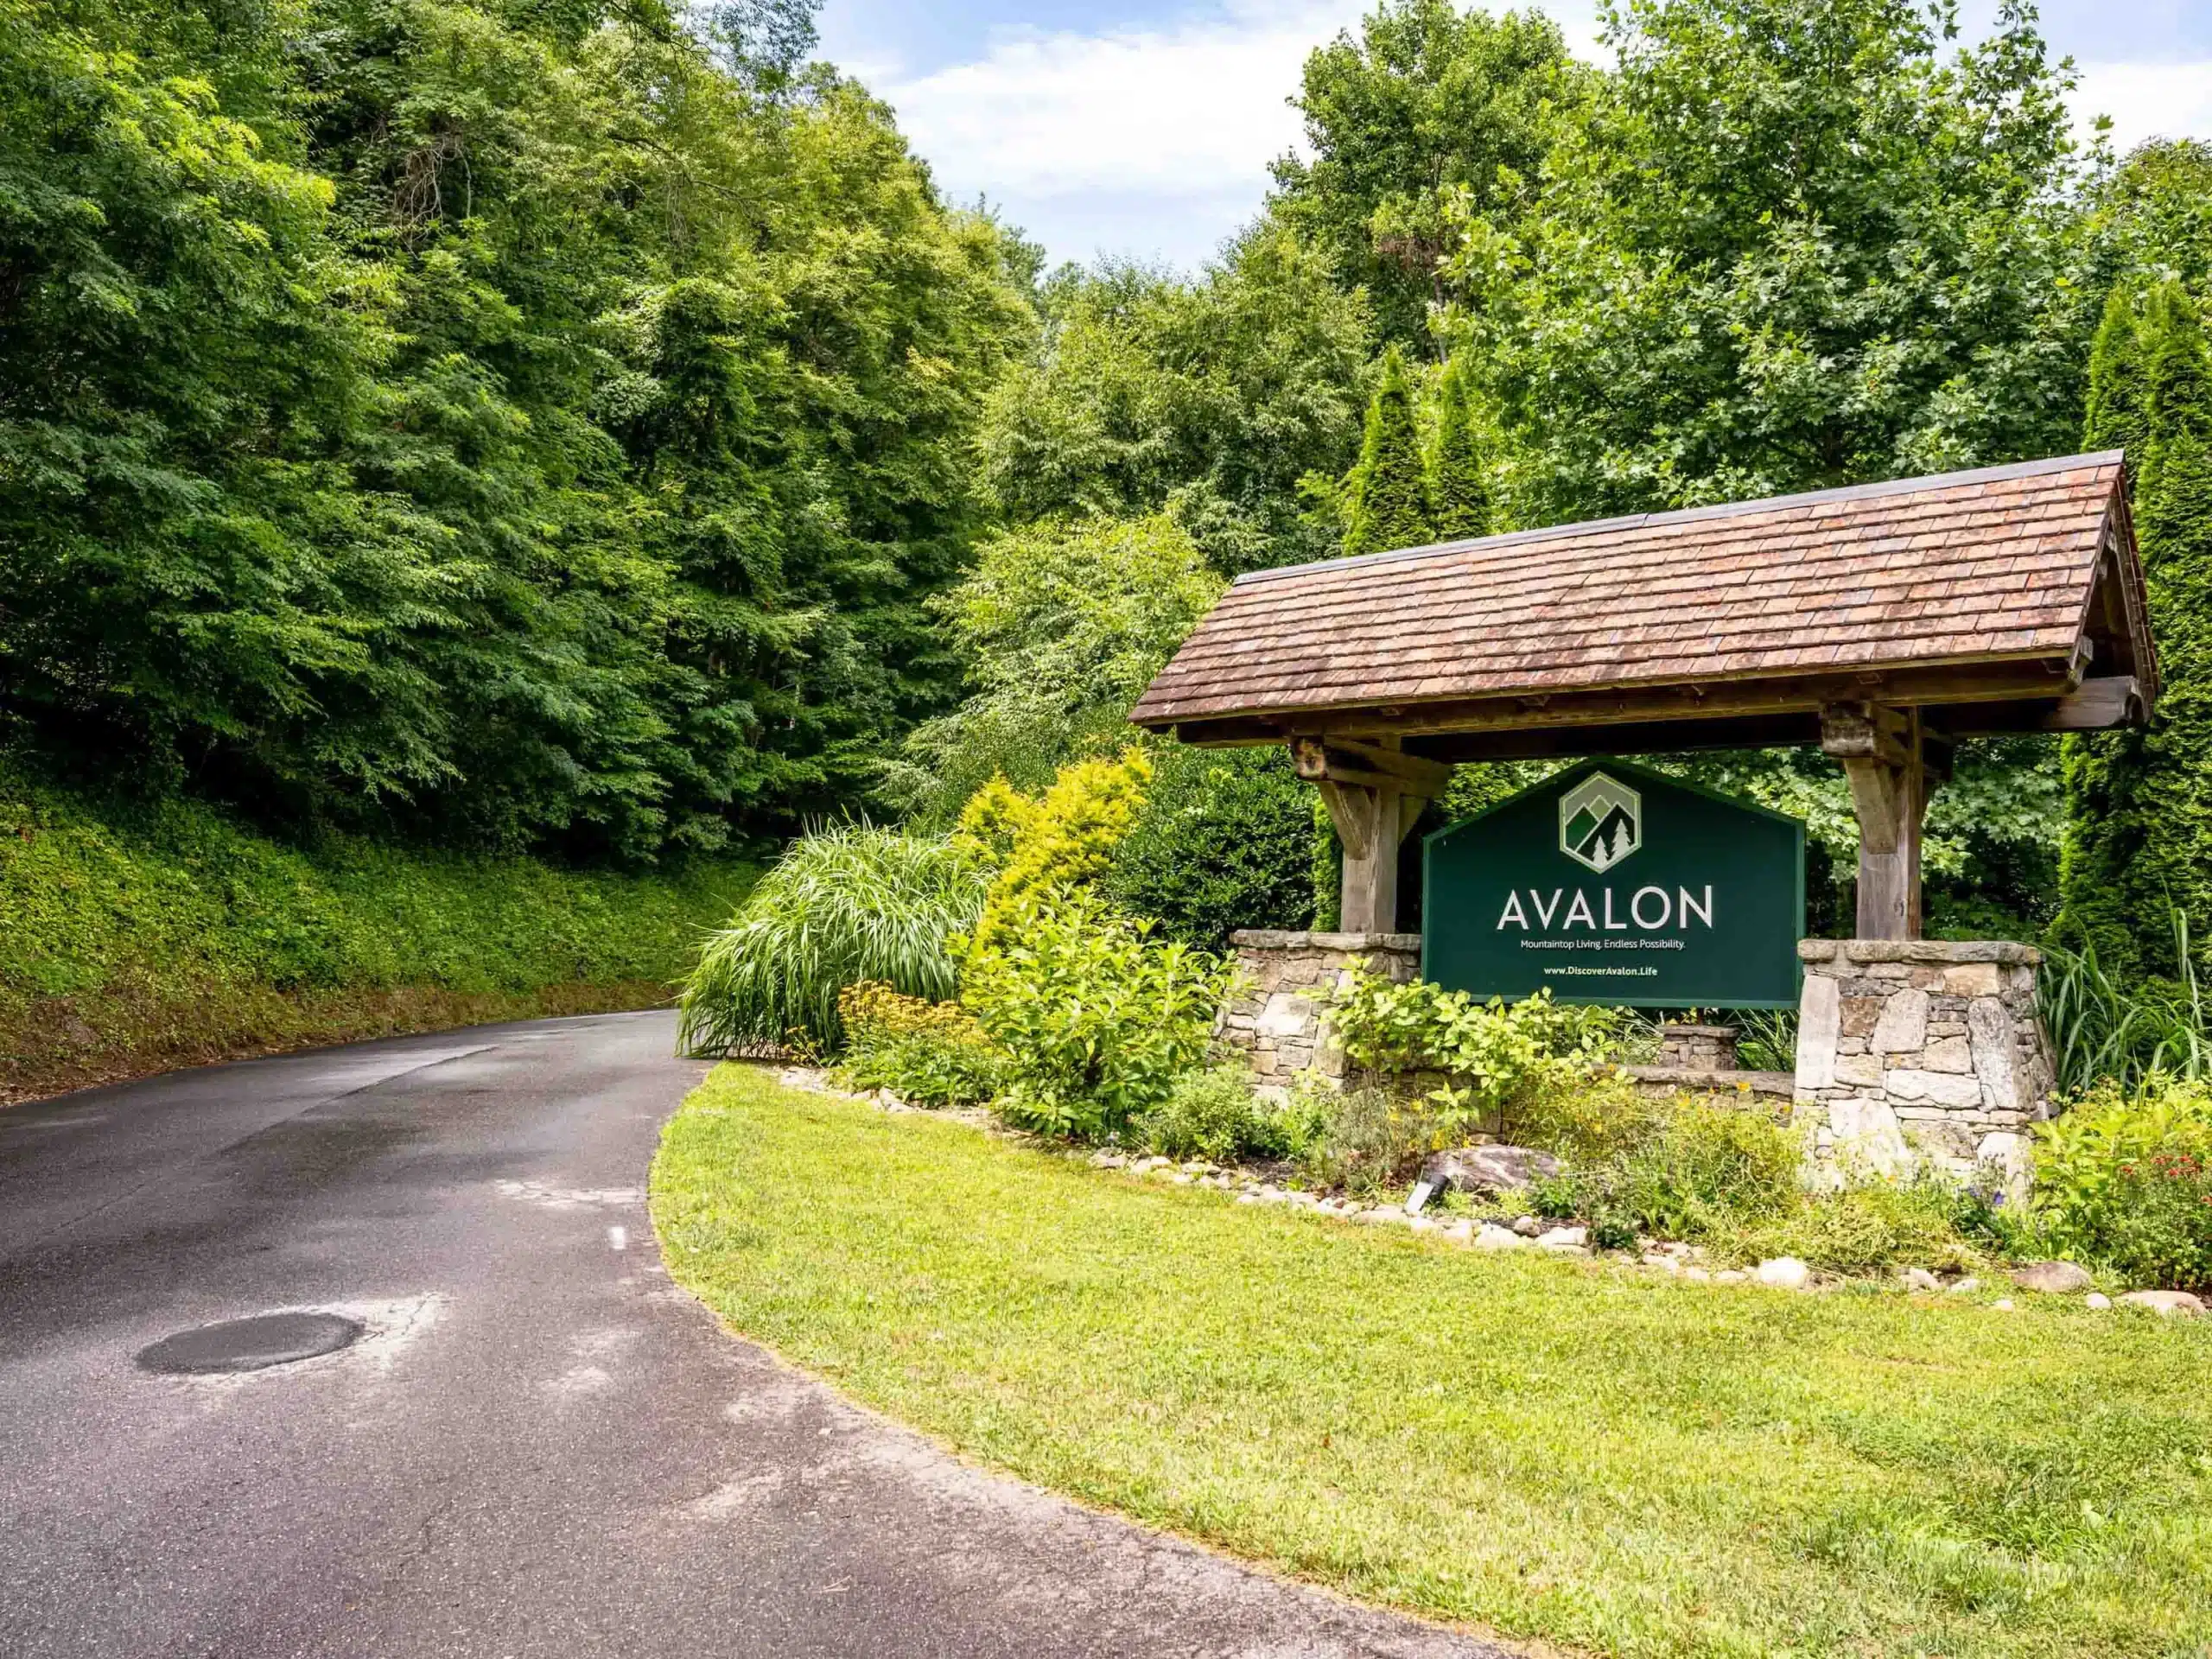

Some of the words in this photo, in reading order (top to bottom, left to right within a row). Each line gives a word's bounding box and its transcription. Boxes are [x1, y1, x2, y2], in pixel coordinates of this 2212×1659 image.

[1497, 885, 1713, 931] AVALON
[1521, 939, 1574, 950] Mountaintop
[1576, 939, 1602, 950] Living.
[1604, 939, 1637, 949] Endless
[1639, 939, 1686, 950] Possibility.
[1543, 966, 1658, 976] www.DiscoverAvalon.Life
